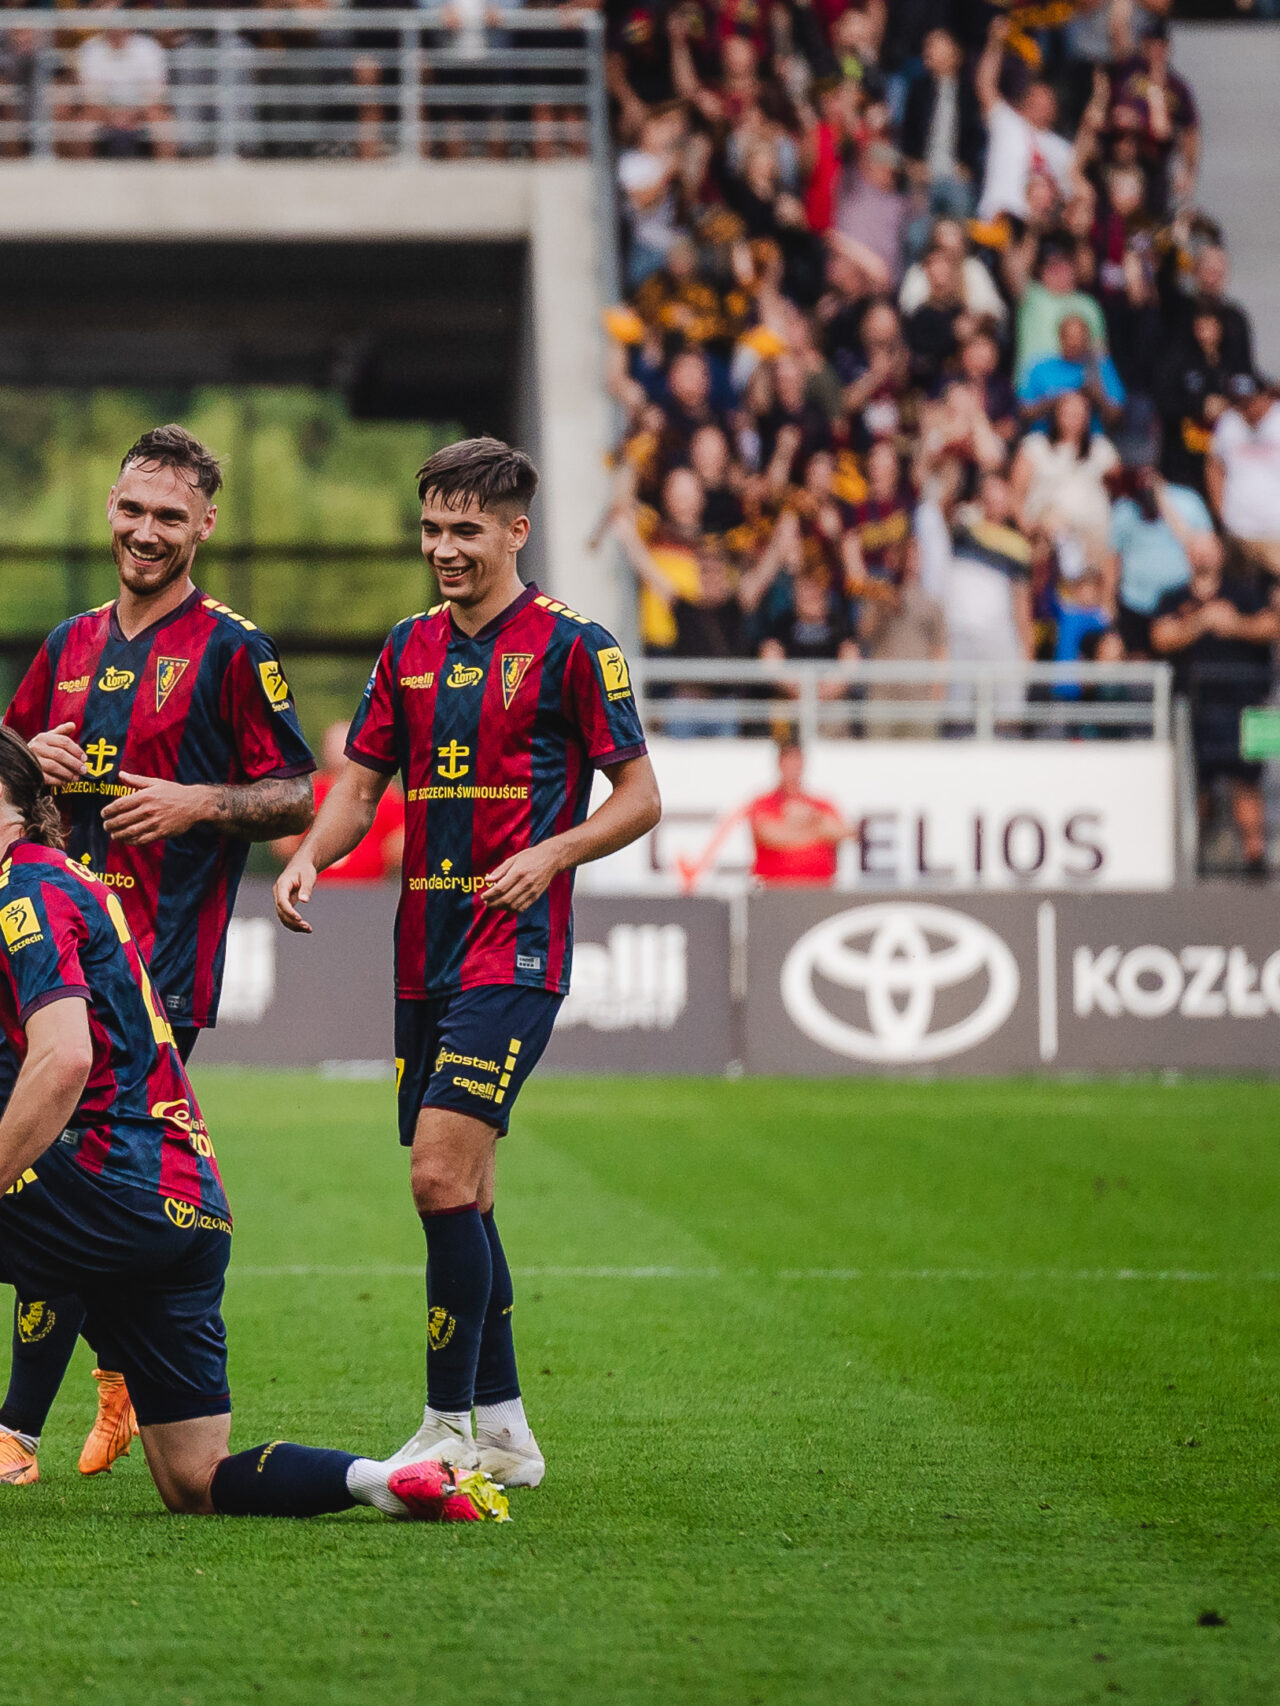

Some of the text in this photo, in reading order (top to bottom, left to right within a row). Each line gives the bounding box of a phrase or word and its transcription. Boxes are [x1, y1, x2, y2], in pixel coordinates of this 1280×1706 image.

[857, 812, 1106, 874] ELIOS
[443, 1051, 501, 1074] dostalk
[452, 1076, 496, 1096] capelli
